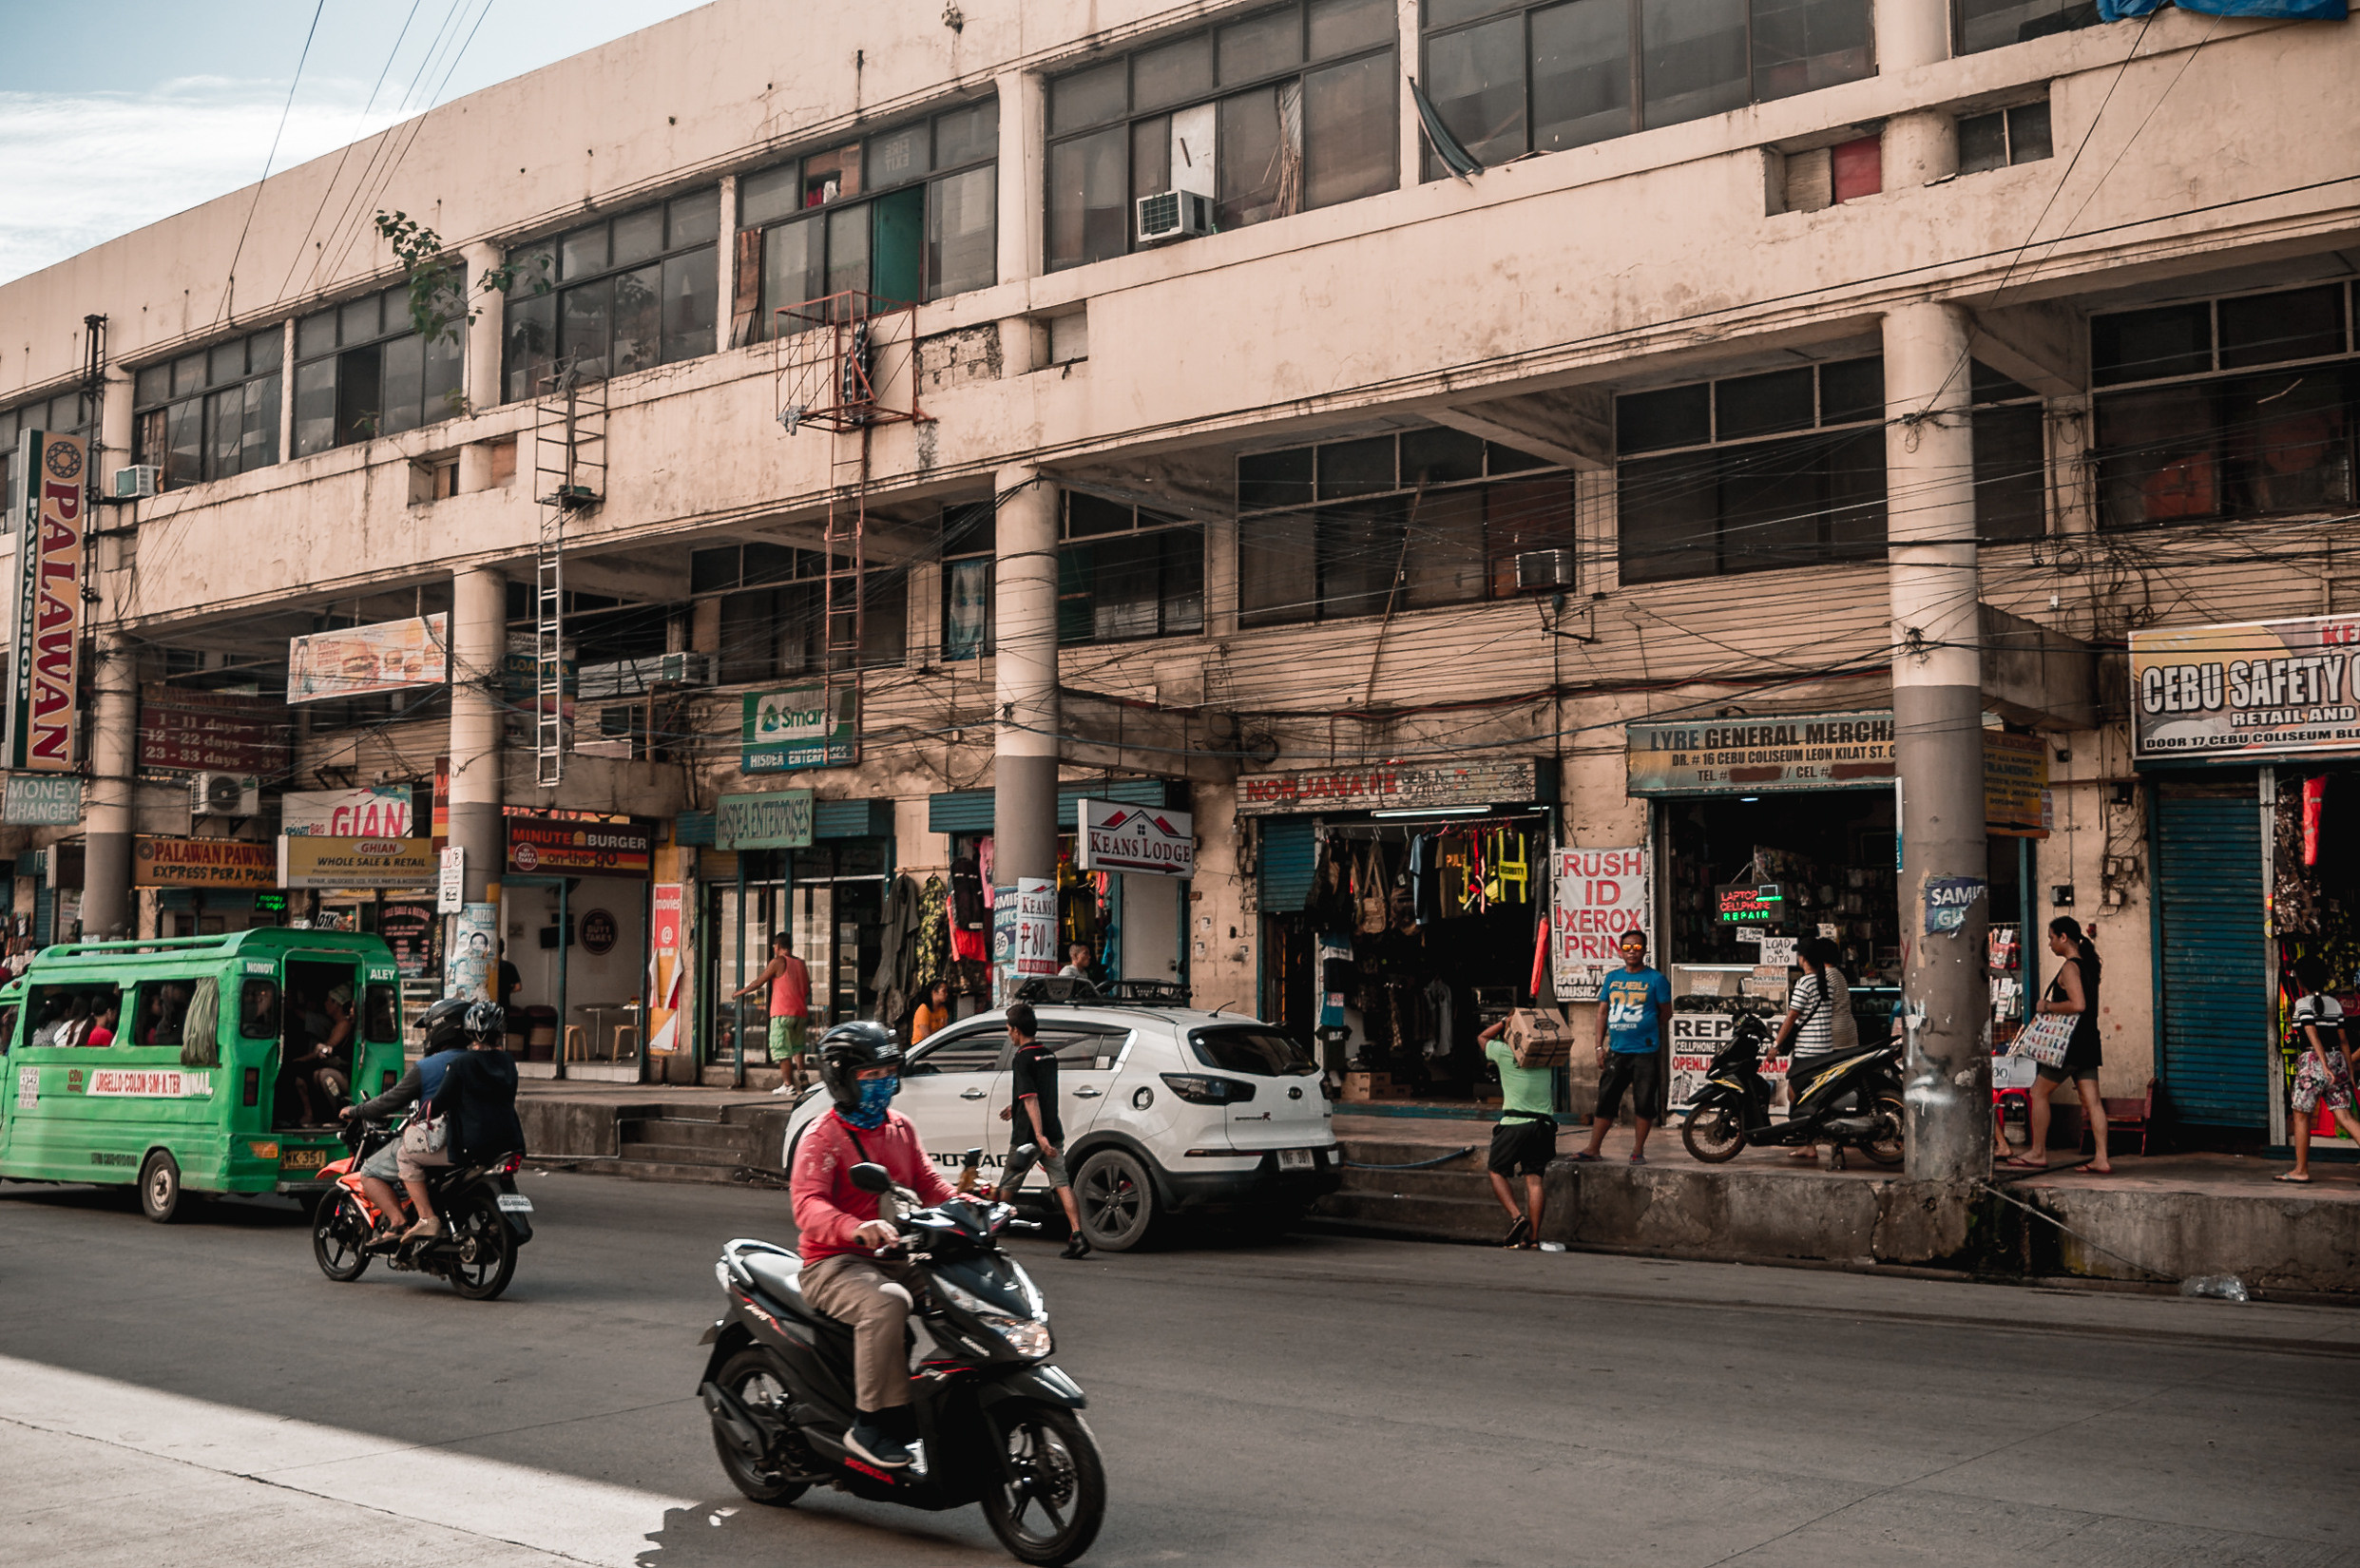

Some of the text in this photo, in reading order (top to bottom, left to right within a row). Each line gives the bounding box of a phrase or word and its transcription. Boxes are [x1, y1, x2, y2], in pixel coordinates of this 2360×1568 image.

[19, 497, 38, 701] PAWNSHOP
[31, 479, 80, 762] PALAWAN
[2142, 662, 2224, 713] CEBU
[2230, 654, 2345, 708] SAFETY
[2232, 706, 2356, 727] RETAIL AND
[205, 718, 241, 734] days
[181, 733, 201, 746] 22
[1650, 729, 1699, 751] LYRE
[1704, 724, 1800, 750] GENERAL
[2146, 738, 2186, 748] DOOR
[2209, 735, 2249, 745] CEBU
[2253, 730, 2331, 743] COLISEUM
[145, 746, 166, 758] 23
[180, 749, 201, 762] 33
[204, 752, 240, 767] days
[750, 752, 784, 768] HISDEA
[1672, 755, 1689, 766] DR.
[1691, 755, 1699, 766] #
[1702, 754, 1715, 765] 16
[1717, 752, 1745, 765] CEBU
[1748, 749, 1803, 763] COLISEUM
[1806, 749, 1832, 761] LEON
[1835, 747, 1866, 760] KILAT
[1869, 747, 1887, 758] ST.
[1698, 769, 1728, 782] TEL #
[1796, 765, 1816, 778] CEL
[1820, 766, 1829, 777] #
[8, 779, 80, 801] MONEY
[1246, 775, 1363, 801] NORJANA
[7, 801, 79, 822] CHANGER
[331, 802, 406, 837] GIAN
[719, 798, 809, 839] HISDEA ENTERPRISES
[361, 842, 397, 854] GHIAN
[512, 829, 646, 850] MINUTE BURGER
[1090, 832, 1191, 863] KEANS LODGE
[154, 842, 221, 864] PALAWAN
[317, 857, 426, 867] WHOLE SALE & RETAIL
[547, 852, 618, 868] on-the-go
[1564, 851, 1641, 877] RUSH
[153, 866, 208, 880] EXPRESS
[210, 868, 241, 881] PERA
[259, 894, 283, 903] money
[1585, 880, 1621, 906] ID
[1720, 890, 1757, 902] LAPTOP
[656, 896, 681, 910] movies
[1022, 896, 1052, 915] KEANS
[1719, 901, 1771, 912] CELLPHONE
[1564, 908, 1641, 933] XEROX
[1723, 909, 1769, 922] REPAIR
[1564, 935, 1621, 959] PRIN
[1765, 938, 1791, 949] LOAD
[1767, 955, 1790, 964] DITO
[370, 968, 395, 980] ALEY
[1558, 985, 1596, 998] MUSIC
[1609, 981, 1649, 991] FUBU
[1608, 990, 1647, 1023] 05
[1676, 1041, 1716, 1053] CELLPHONE
[1673, 1056, 1714, 1071] OPENLI
